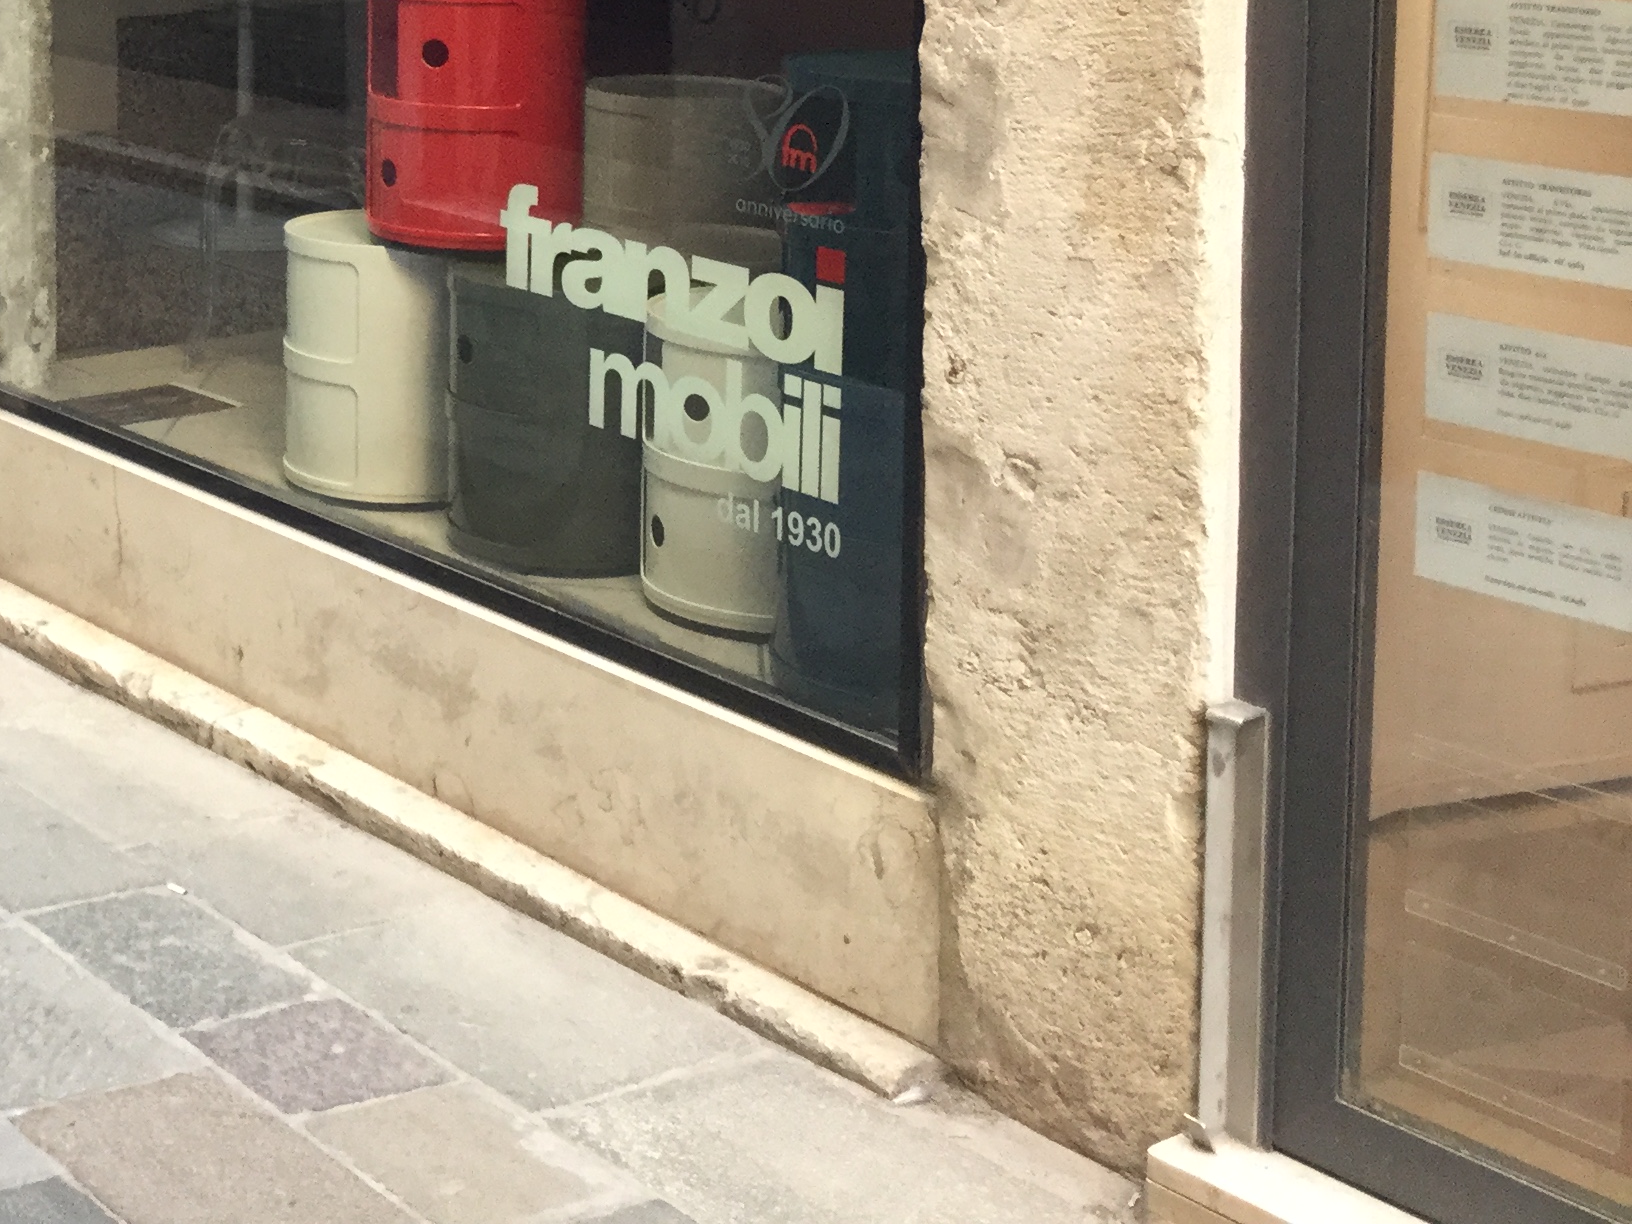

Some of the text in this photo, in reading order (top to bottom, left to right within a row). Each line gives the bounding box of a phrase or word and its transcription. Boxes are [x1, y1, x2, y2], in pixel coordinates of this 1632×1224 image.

[735, 197, 845, 235] anniversario
[499, 183, 846, 376] franzoi
[588, 345, 842, 505] mobili
[717, 492, 841, 559] dal 1930
